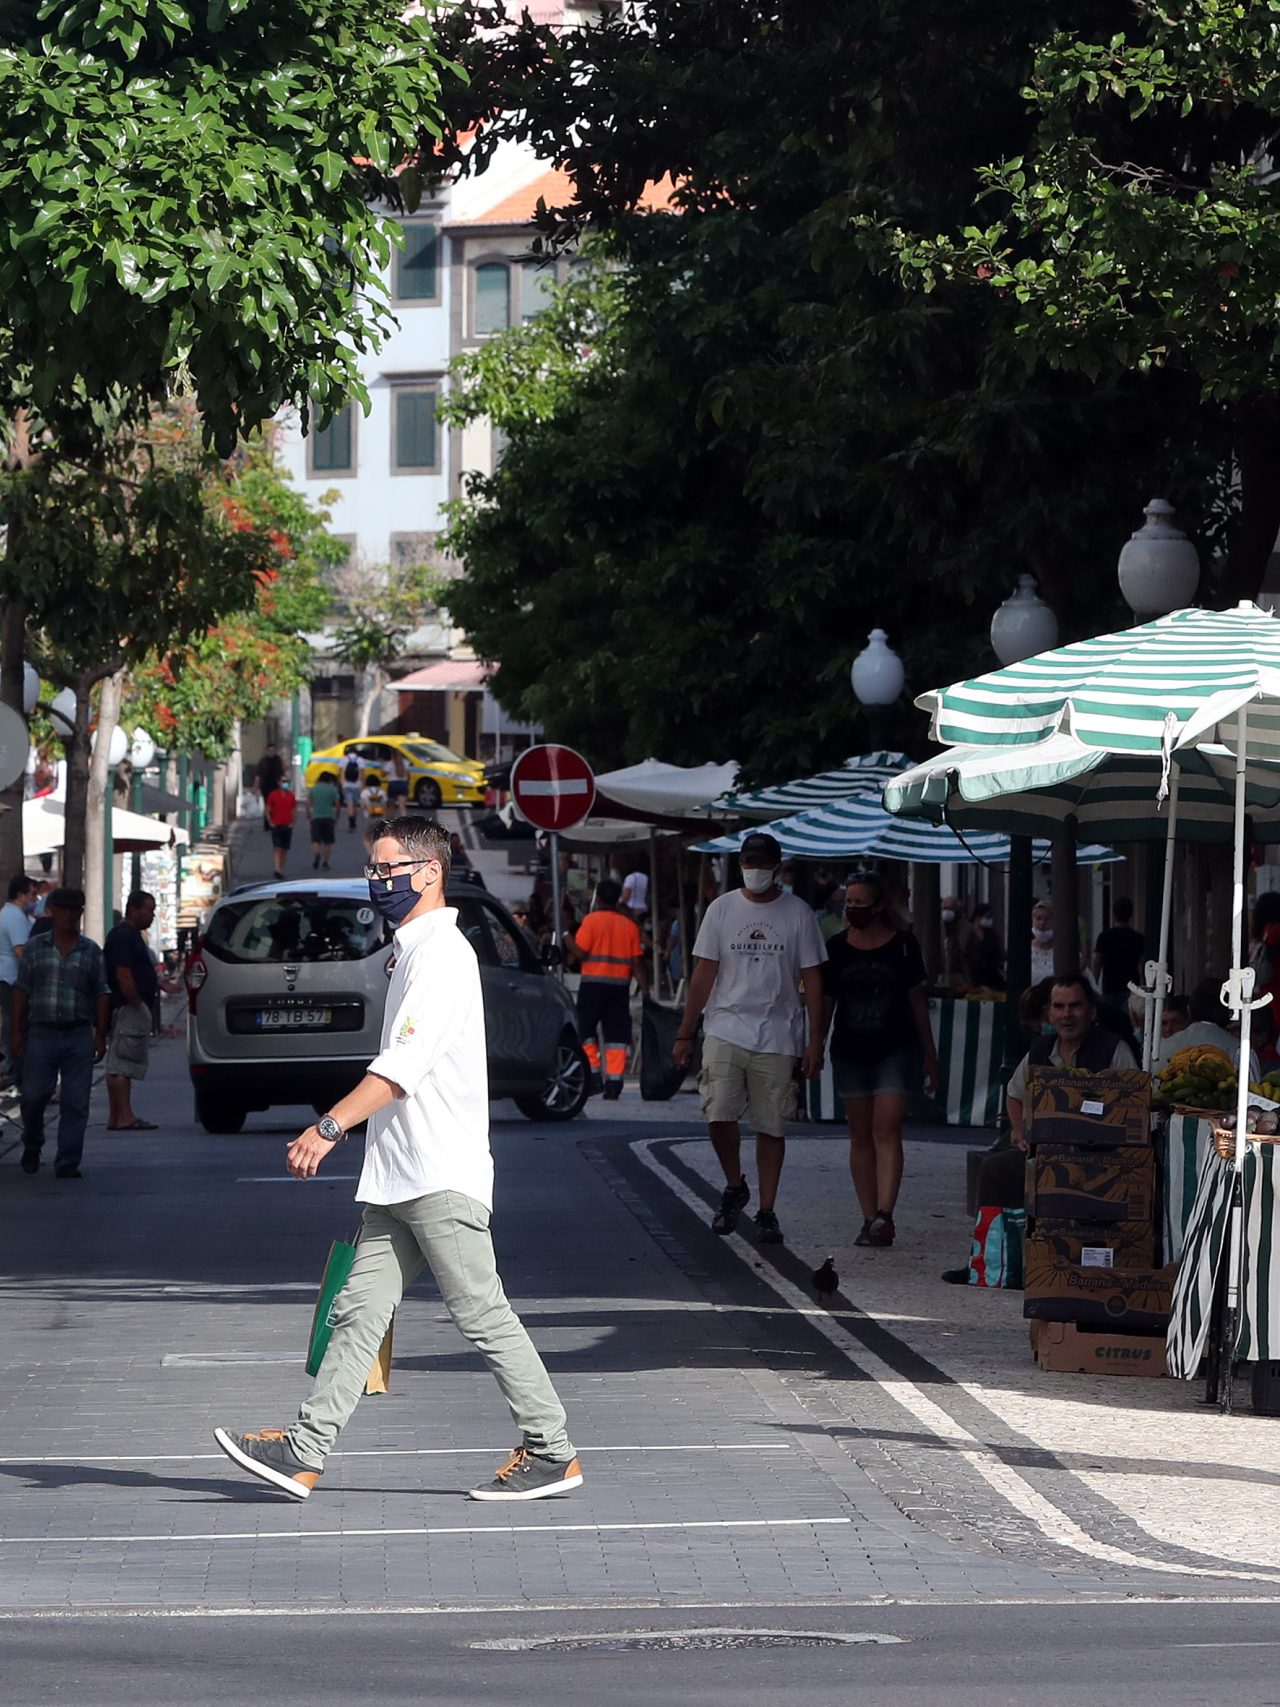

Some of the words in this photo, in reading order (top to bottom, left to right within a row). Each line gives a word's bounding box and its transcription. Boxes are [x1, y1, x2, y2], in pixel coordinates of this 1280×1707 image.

[730, 943, 785, 951] QUIKSILVER
[1068, 1274, 1112, 1287] Banana
[1095, 1347, 1152, 1360] CITRUS
